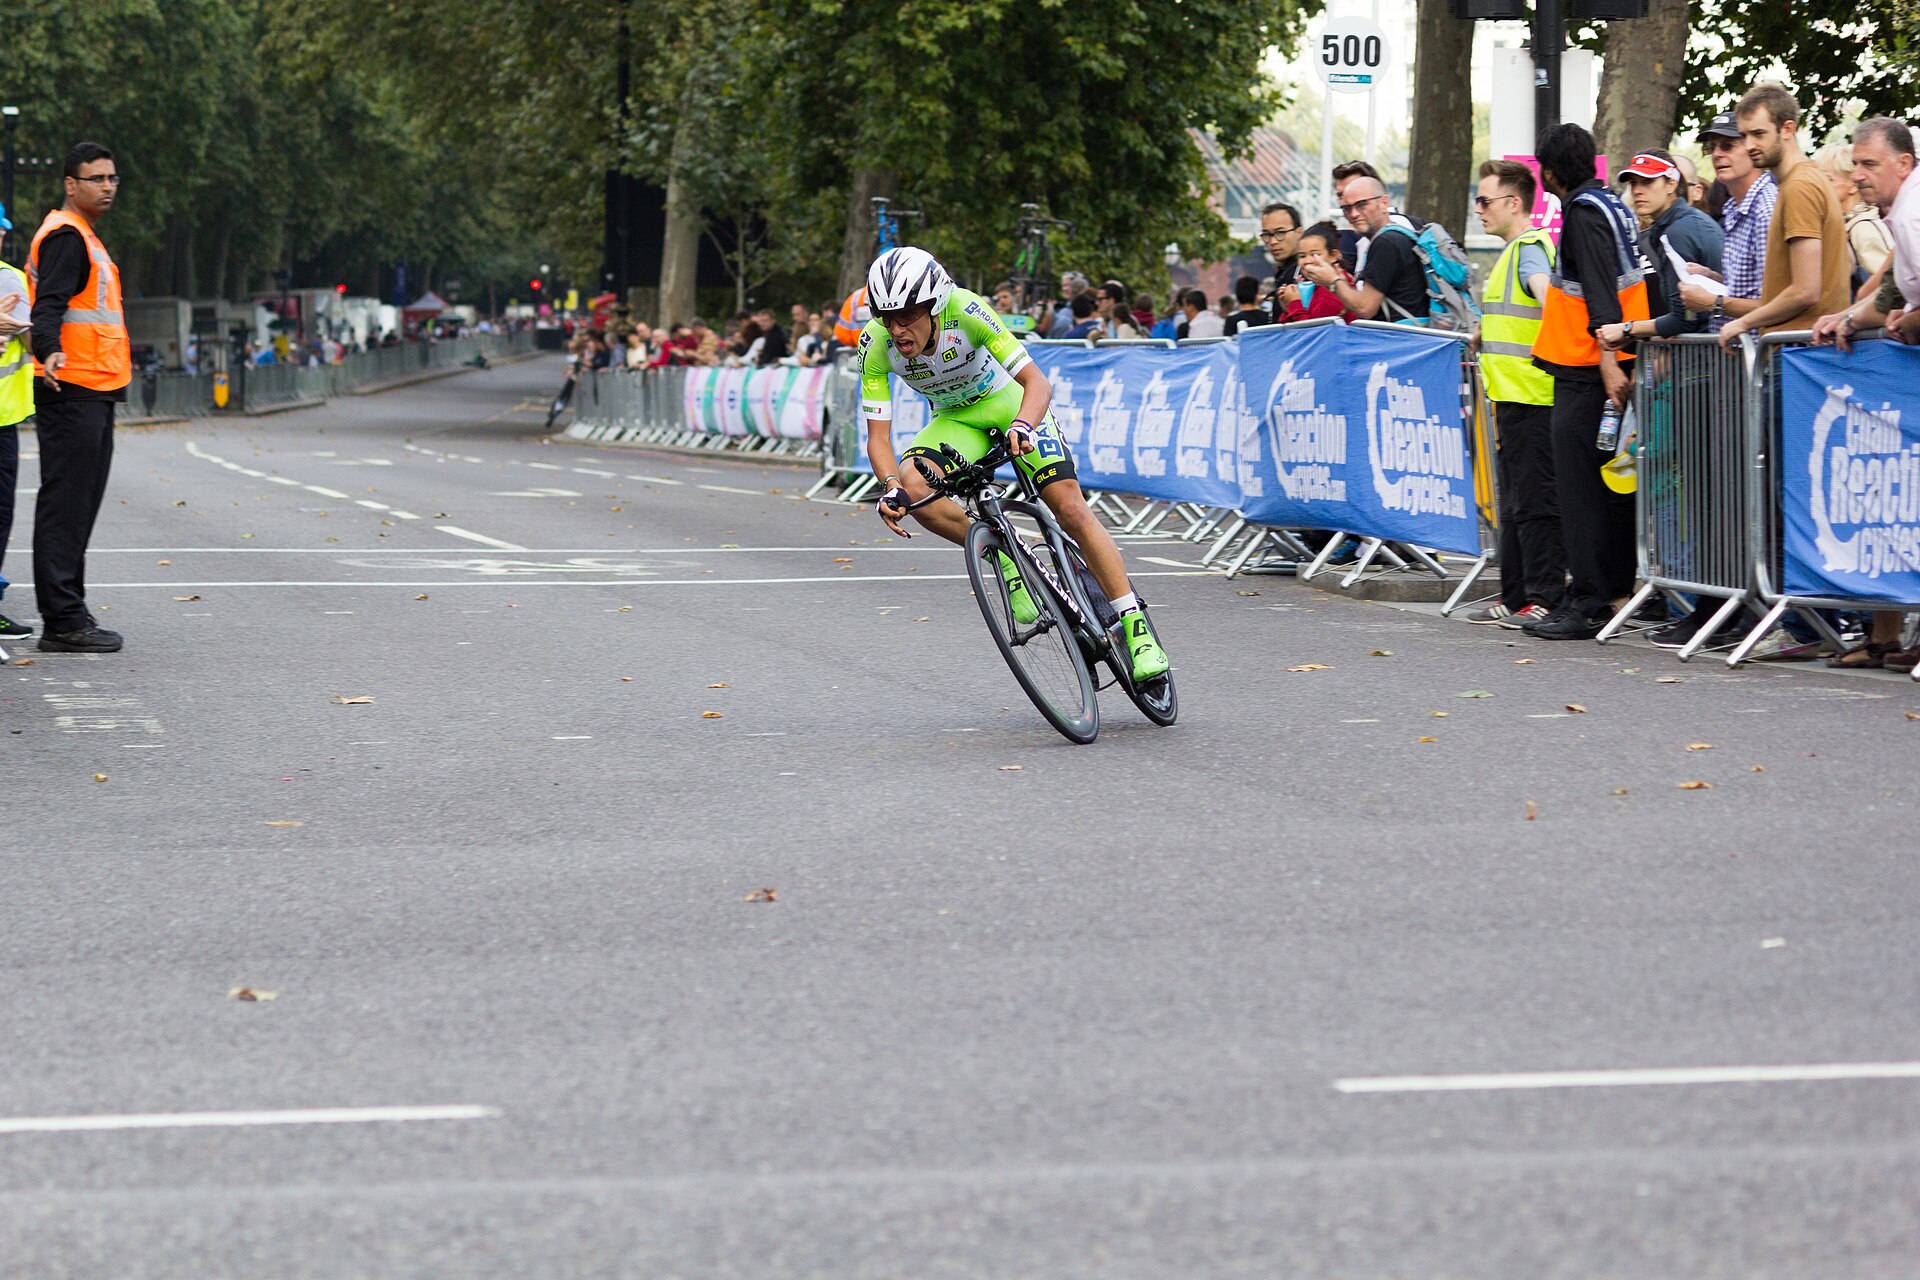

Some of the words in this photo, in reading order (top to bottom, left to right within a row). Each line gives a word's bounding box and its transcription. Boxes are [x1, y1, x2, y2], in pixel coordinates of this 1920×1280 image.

[1322, 34, 1381, 67] 500
[964, 301, 1002, 334] BARDIANI
[1379, 409, 1465, 480] Reaction
[1829, 442, 1920, 524] Reacti
[1859, 524, 1920, 578] cycles
